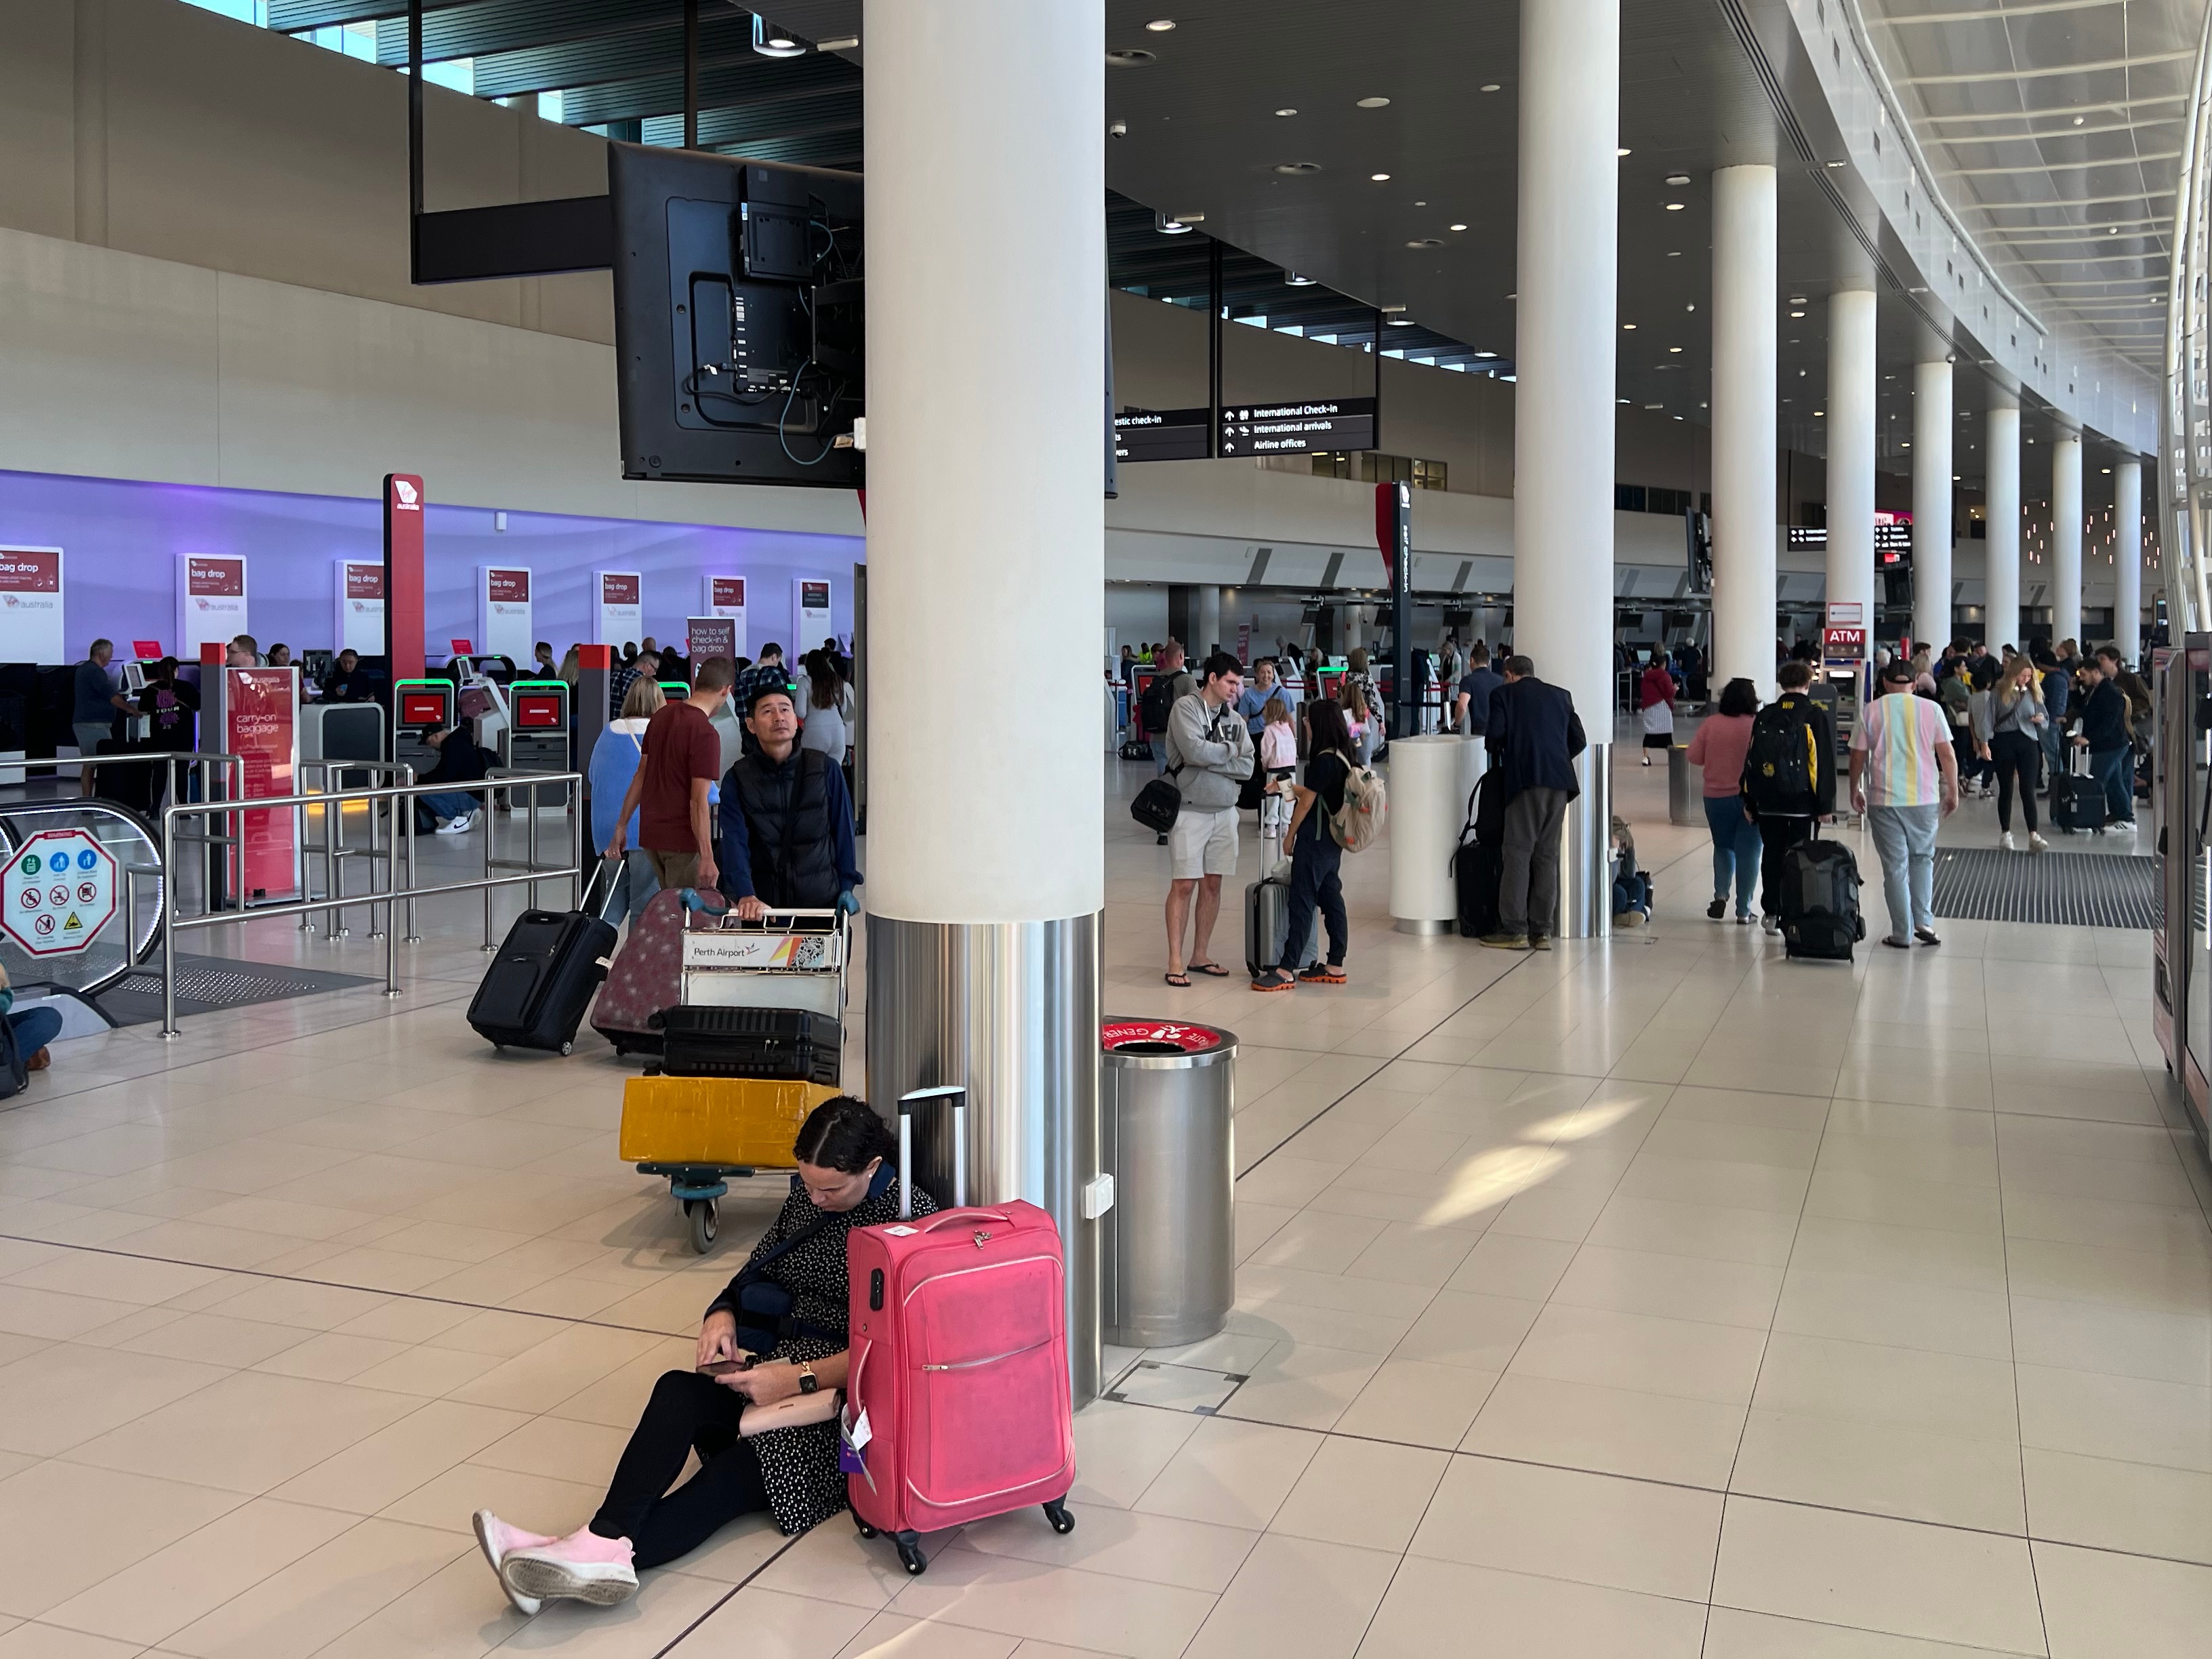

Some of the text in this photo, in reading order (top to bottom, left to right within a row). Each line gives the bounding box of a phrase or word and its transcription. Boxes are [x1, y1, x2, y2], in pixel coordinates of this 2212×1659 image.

[1254, 405, 1338, 418] International Check-in
[1115, 415, 1162, 426] estic check-in
[1254, 421, 1332, 434] International arrivals
[1254, 438, 1306, 449] Airline offices
[18, 562, 38, 573] drop
[191, 569, 225, 579] bag drop
[348, 574, 378, 583] bag drop
[491, 579, 501, 588] bag
[718, 627, 730, 635] self
[1830, 630, 1859, 642] ATM
[692, 636, 729, 644] check-in &
[692, 644, 724, 654] bag drop
[237, 714, 276, 724] carry-on
[237, 724, 279, 734] baggage
[694, 947, 745, 958] Perth Airport
[1103, 1028, 1149, 1041] GENER
